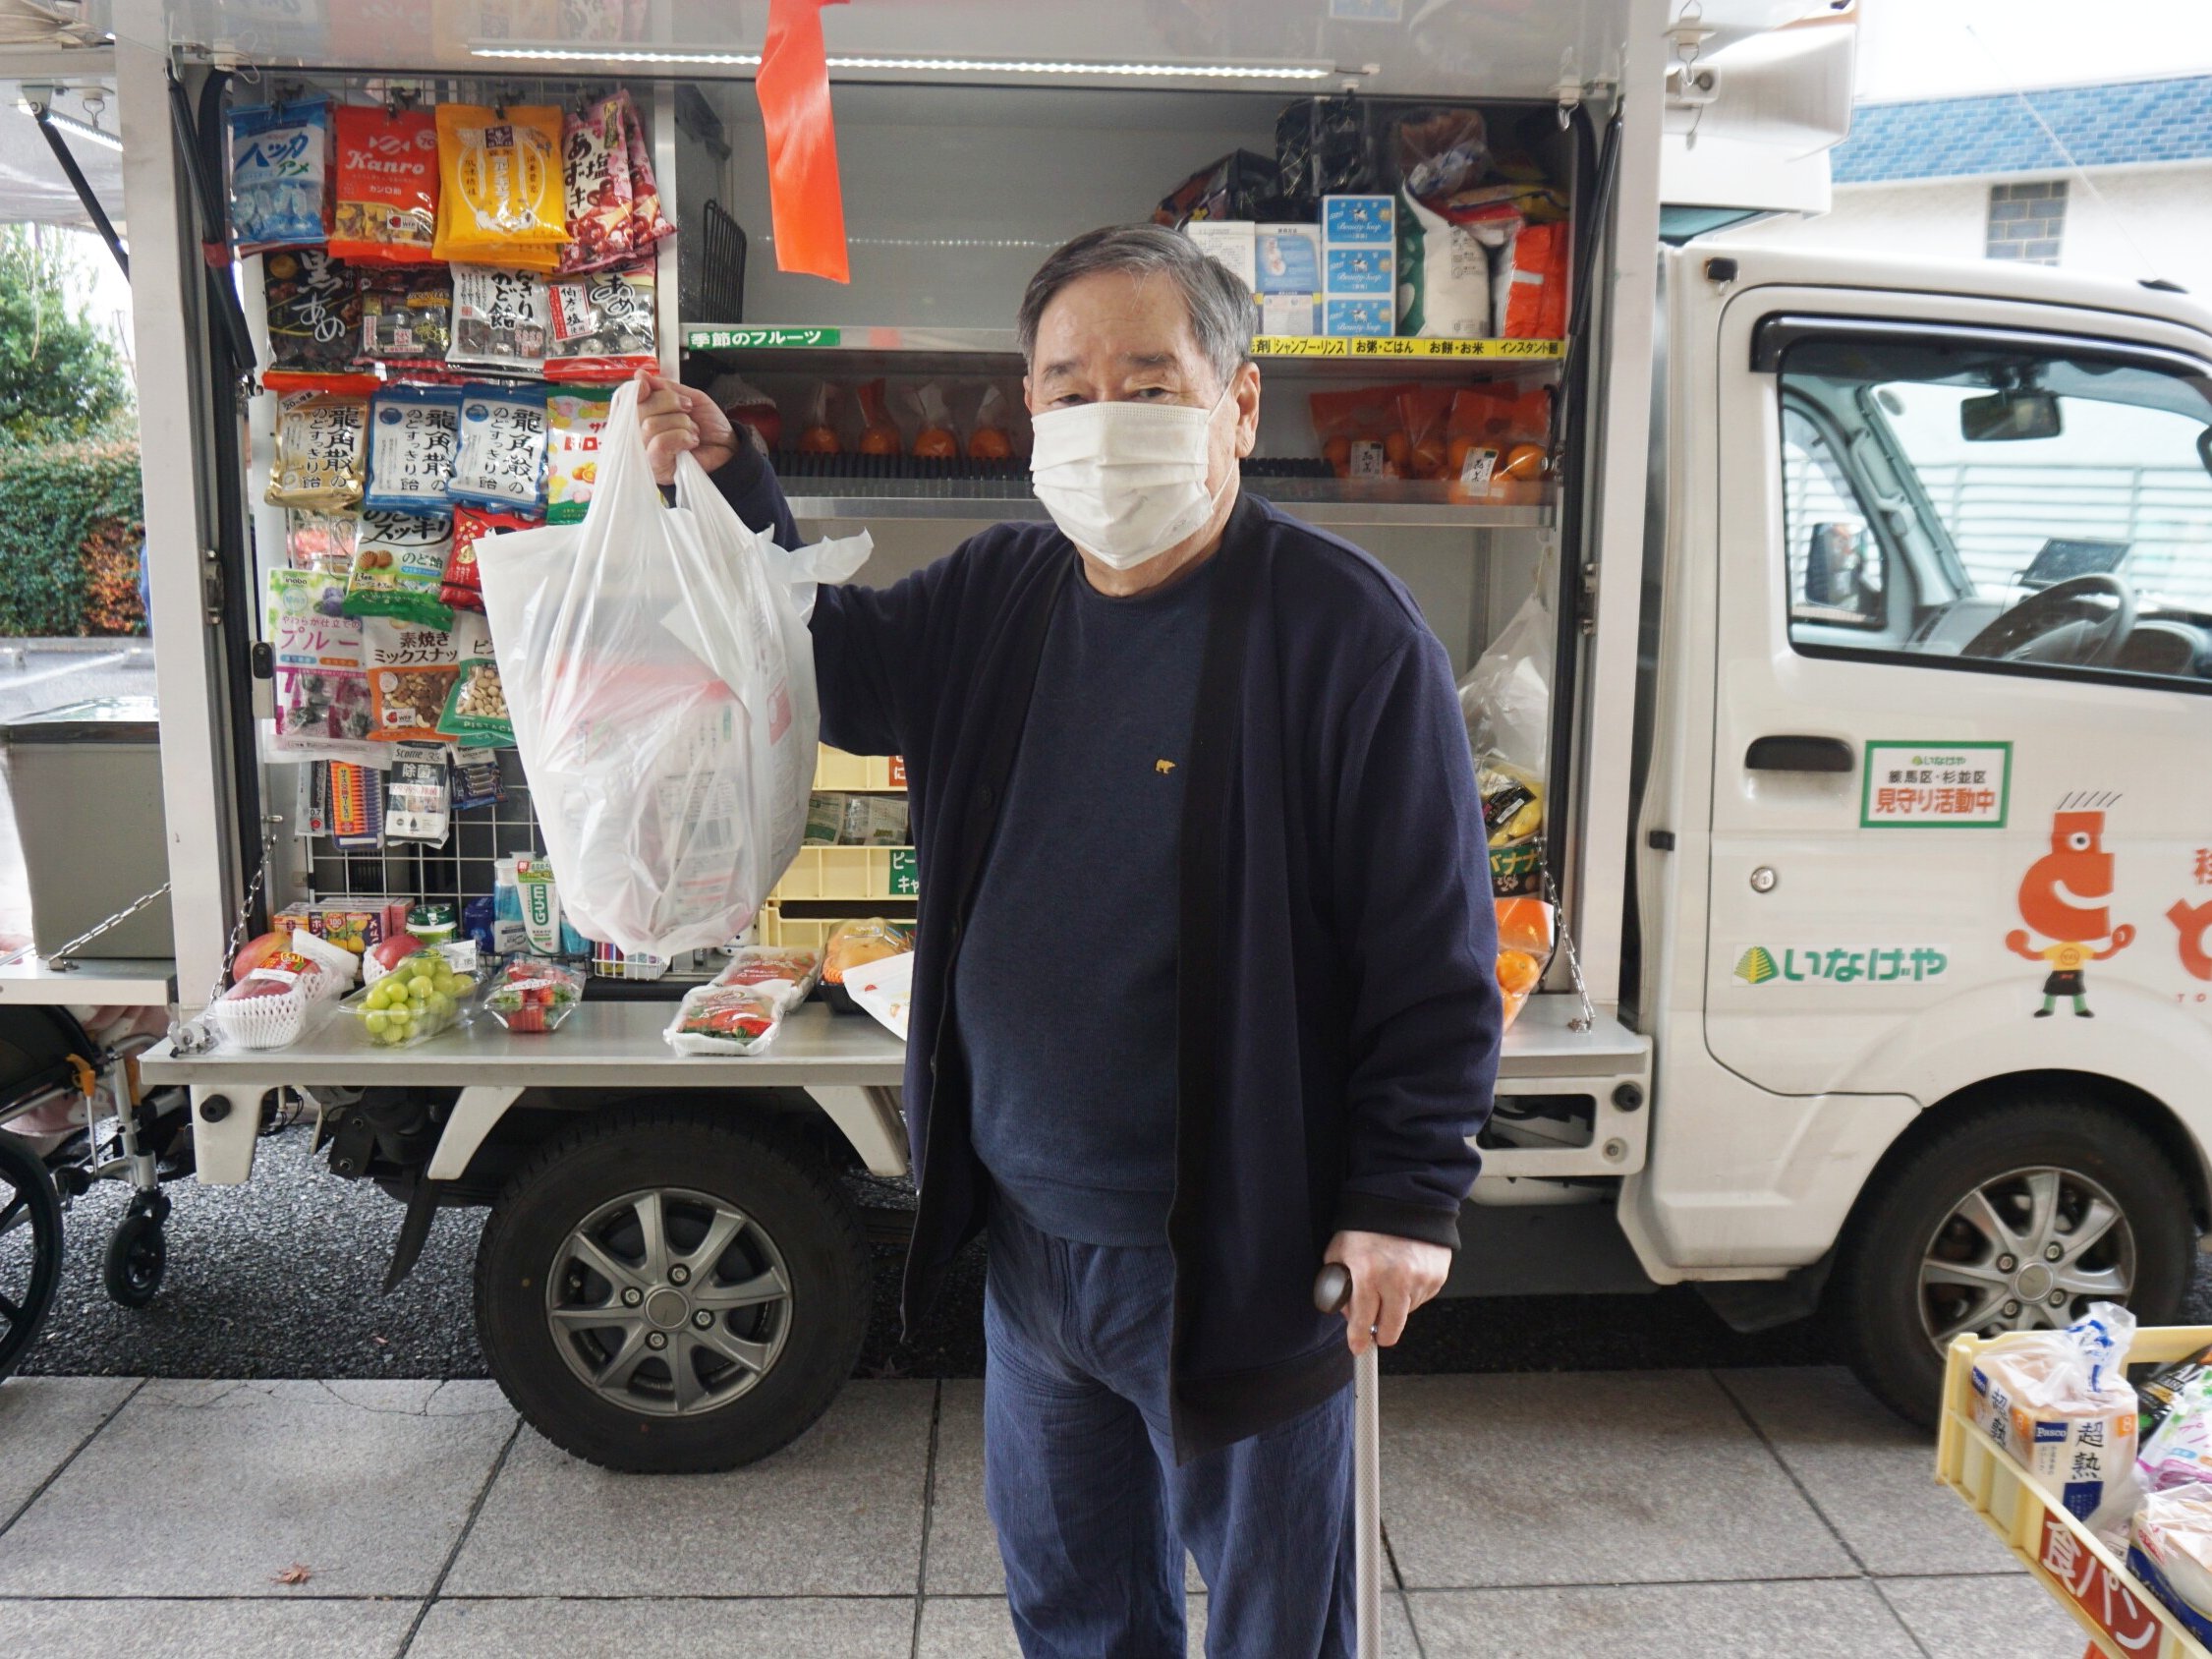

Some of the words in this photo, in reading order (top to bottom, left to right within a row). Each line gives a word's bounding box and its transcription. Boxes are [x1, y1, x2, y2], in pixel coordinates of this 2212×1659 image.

[235, 131, 309, 171] ハッカ
[345, 149, 425, 174] Kanro
[278, 160, 310, 176] アメ
[587, 152, 610, 180] 塩
[488, 273, 514, 328] のど飴
[691, 330, 822, 348] 季節のフルーツ
[1251, 339, 1271, 353] 剤
[1356, 339, 1414, 354] お粥・ごはん
[1430, 341, 1485, 355] お餅・お米
[303, 408, 328, 488] のどすっきり飴
[322, 406, 363, 487] 龍角散の
[401, 409, 423, 491] のどすっきり飴
[423, 409, 458, 491] 龍角散の
[479, 408, 509, 489] のどすっきり飴
[502, 409, 543, 493] 龍角散の
[402, 552, 443, 569] のど飴
[283, 615, 362, 629] やわらか仕立ての
[400, 631, 449, 649] 素焼き
[1889, 771, 1986, 784] 練馬区・杉並区
[1875, 787, 1996, 814] 見守り活動中
[1784, 947, 1949, 983] いなげや
[2036, 1428, 2068, 1438] Pasco
[2071, 1421, 2104, 1480] 超熟
[2042, 1519, 2156, 1650] 食パン
